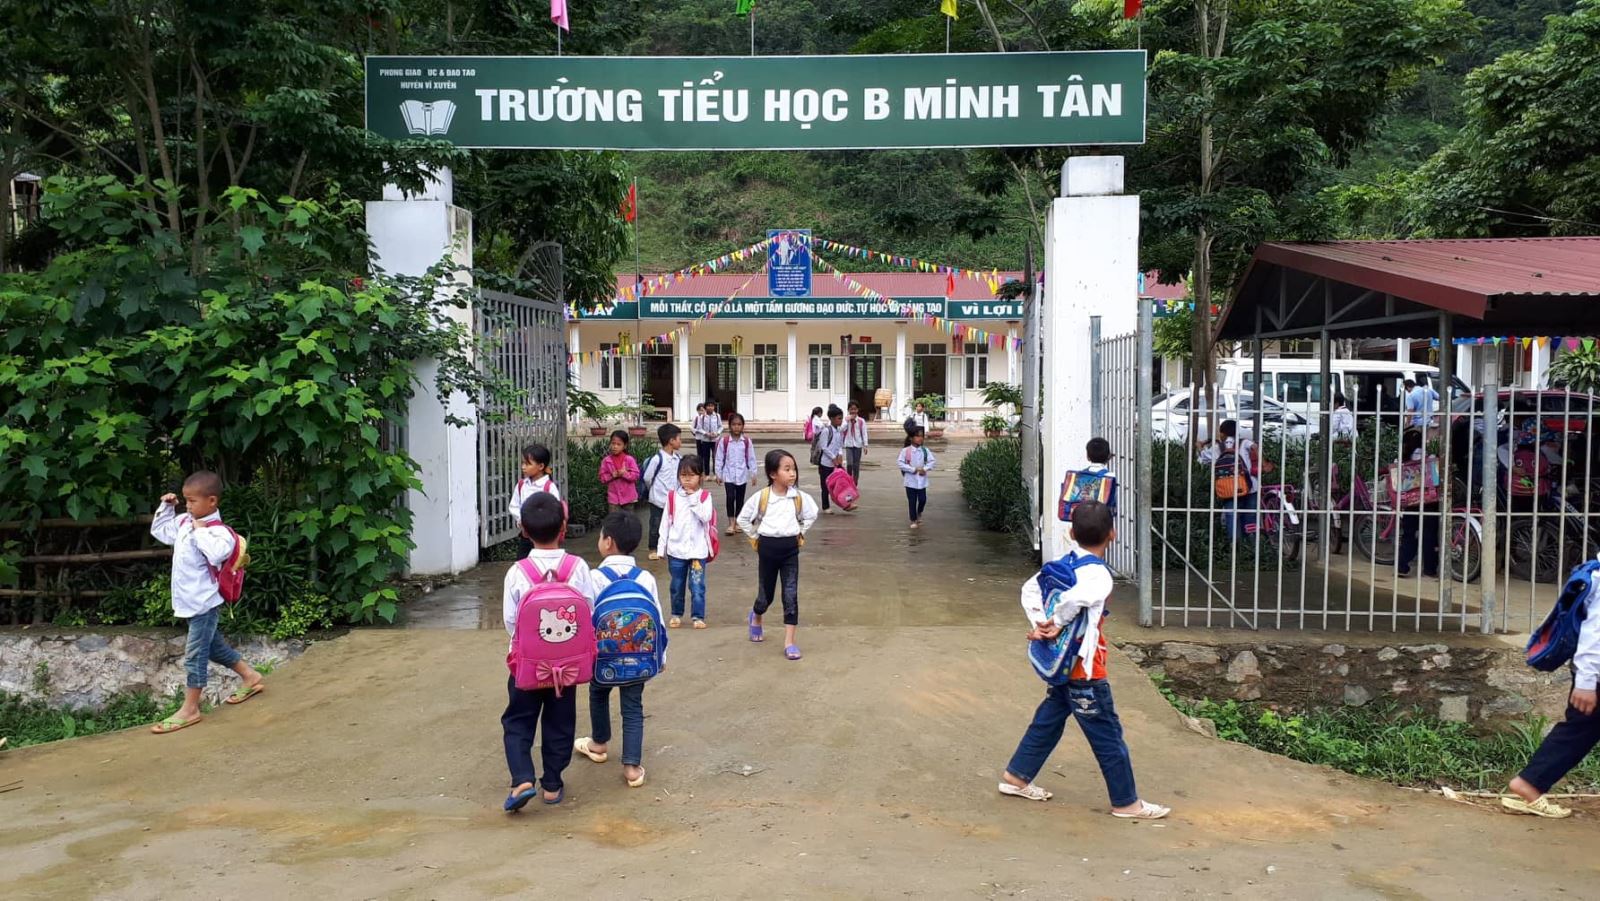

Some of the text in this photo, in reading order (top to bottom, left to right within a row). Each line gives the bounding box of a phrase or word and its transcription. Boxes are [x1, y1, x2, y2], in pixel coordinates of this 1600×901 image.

[439, 68, 445, 77] &
[475, 77, 643, 122] TRƯỜNG
[764, 88, 848, 129] HỌC
[864, 88, 890, 120] B
[1037, 74, 1121, 117] TÂN
[816, 303, 834, 315] ĐẠO
[870, 302, 888, 315] HỌC
[926, 302, 942, 314] TẠO
[961, 303, 978, 315] VÌ
[983, 304, 1012, 316] LỢI
